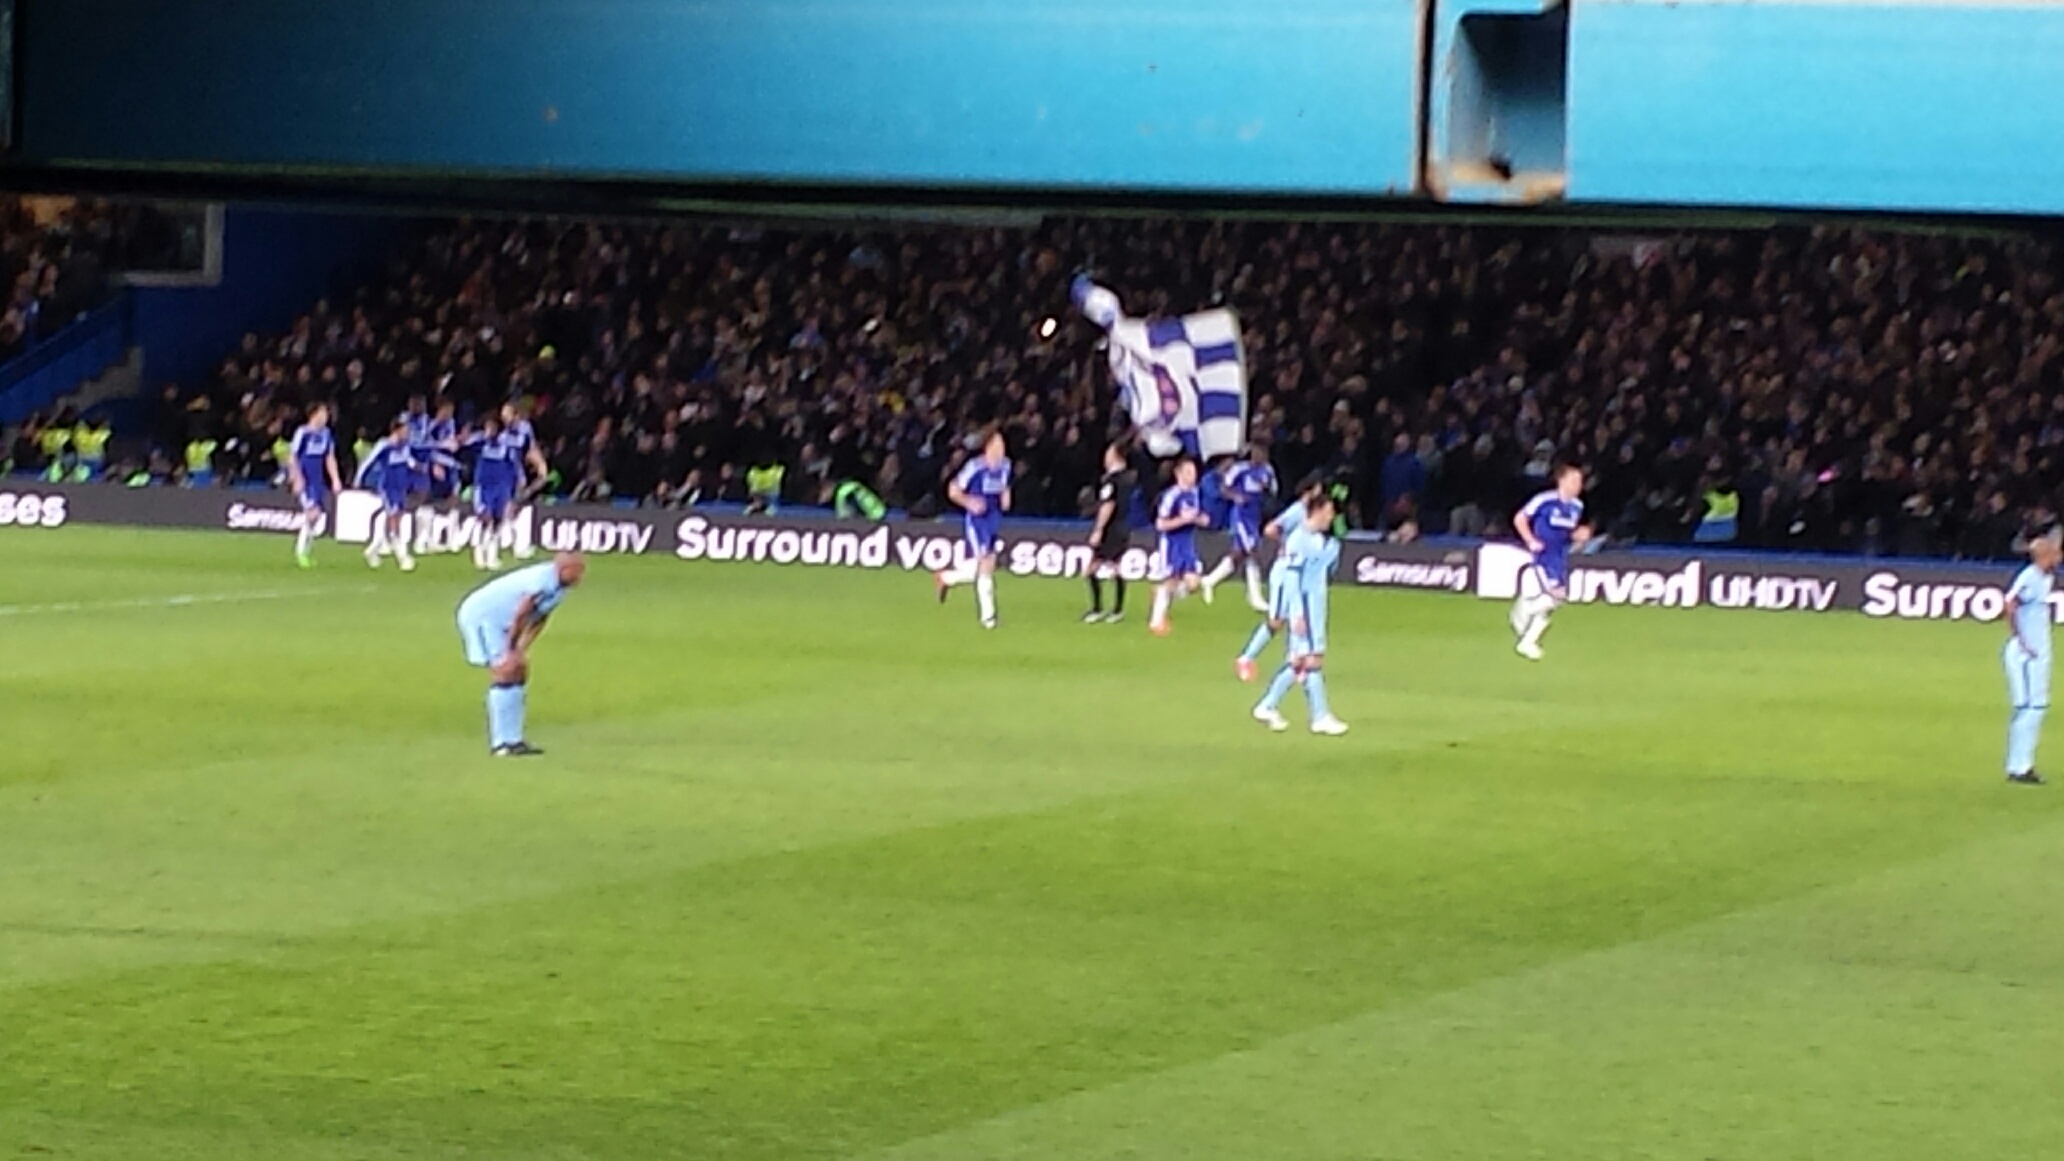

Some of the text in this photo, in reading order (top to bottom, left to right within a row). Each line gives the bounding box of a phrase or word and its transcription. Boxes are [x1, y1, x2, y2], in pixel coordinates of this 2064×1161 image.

[541, 518, 654, 554] UHDTV
[676, 516, 888, 567] Surround
[896, 536, 1005, 572] you
[1711, 574, 1837, 611] UHDTV
